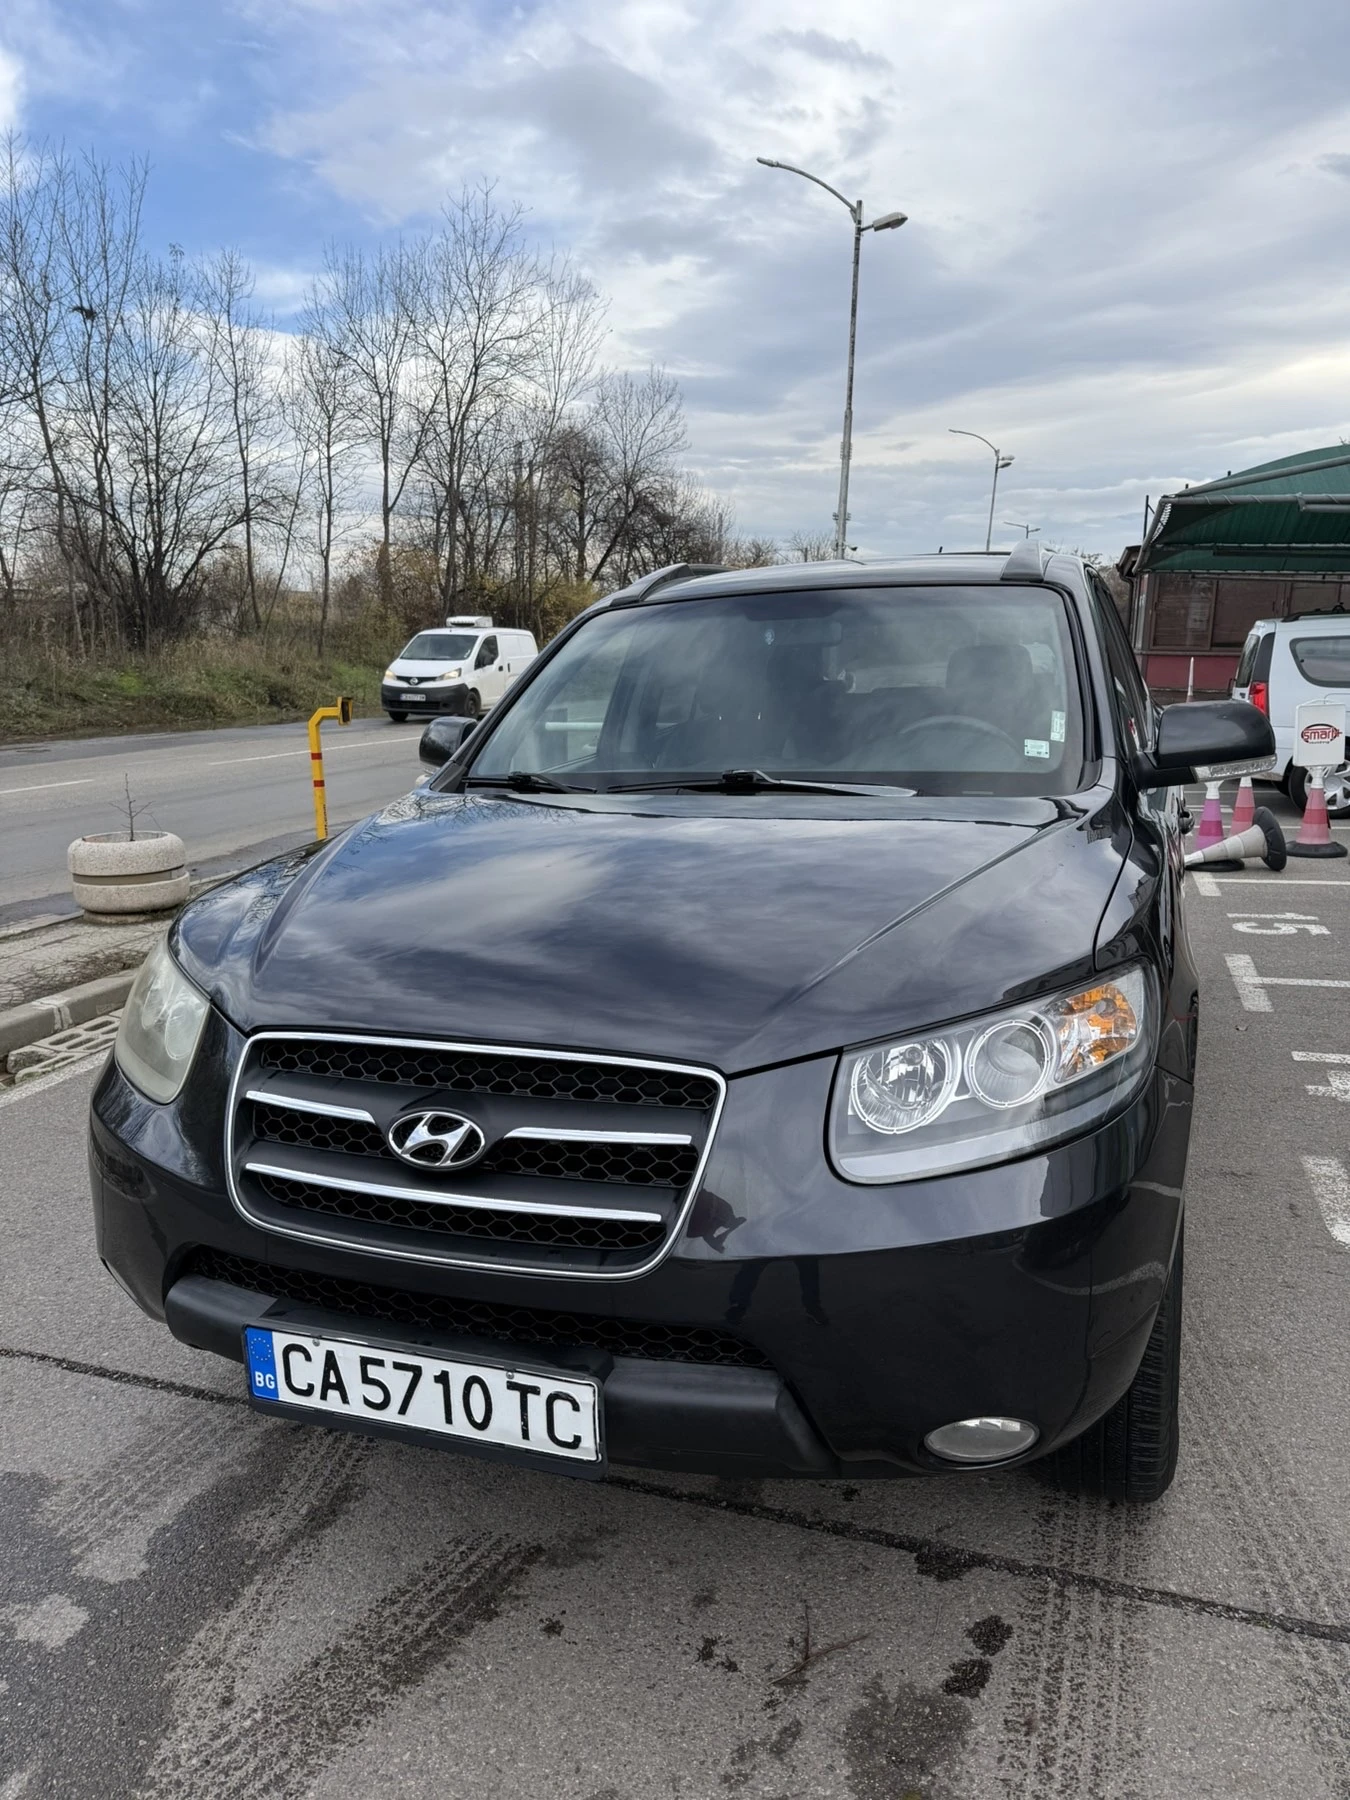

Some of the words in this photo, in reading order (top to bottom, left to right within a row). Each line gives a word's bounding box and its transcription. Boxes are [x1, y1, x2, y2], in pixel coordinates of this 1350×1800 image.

[1226, 912, 1331, 935] 15
[255, 1371, 275, 1389] BG
[282, 1343, 350, 1406] CA
[360, 1355, 493, 1431] 5710
[506, 1381, 582, 1450] TC
